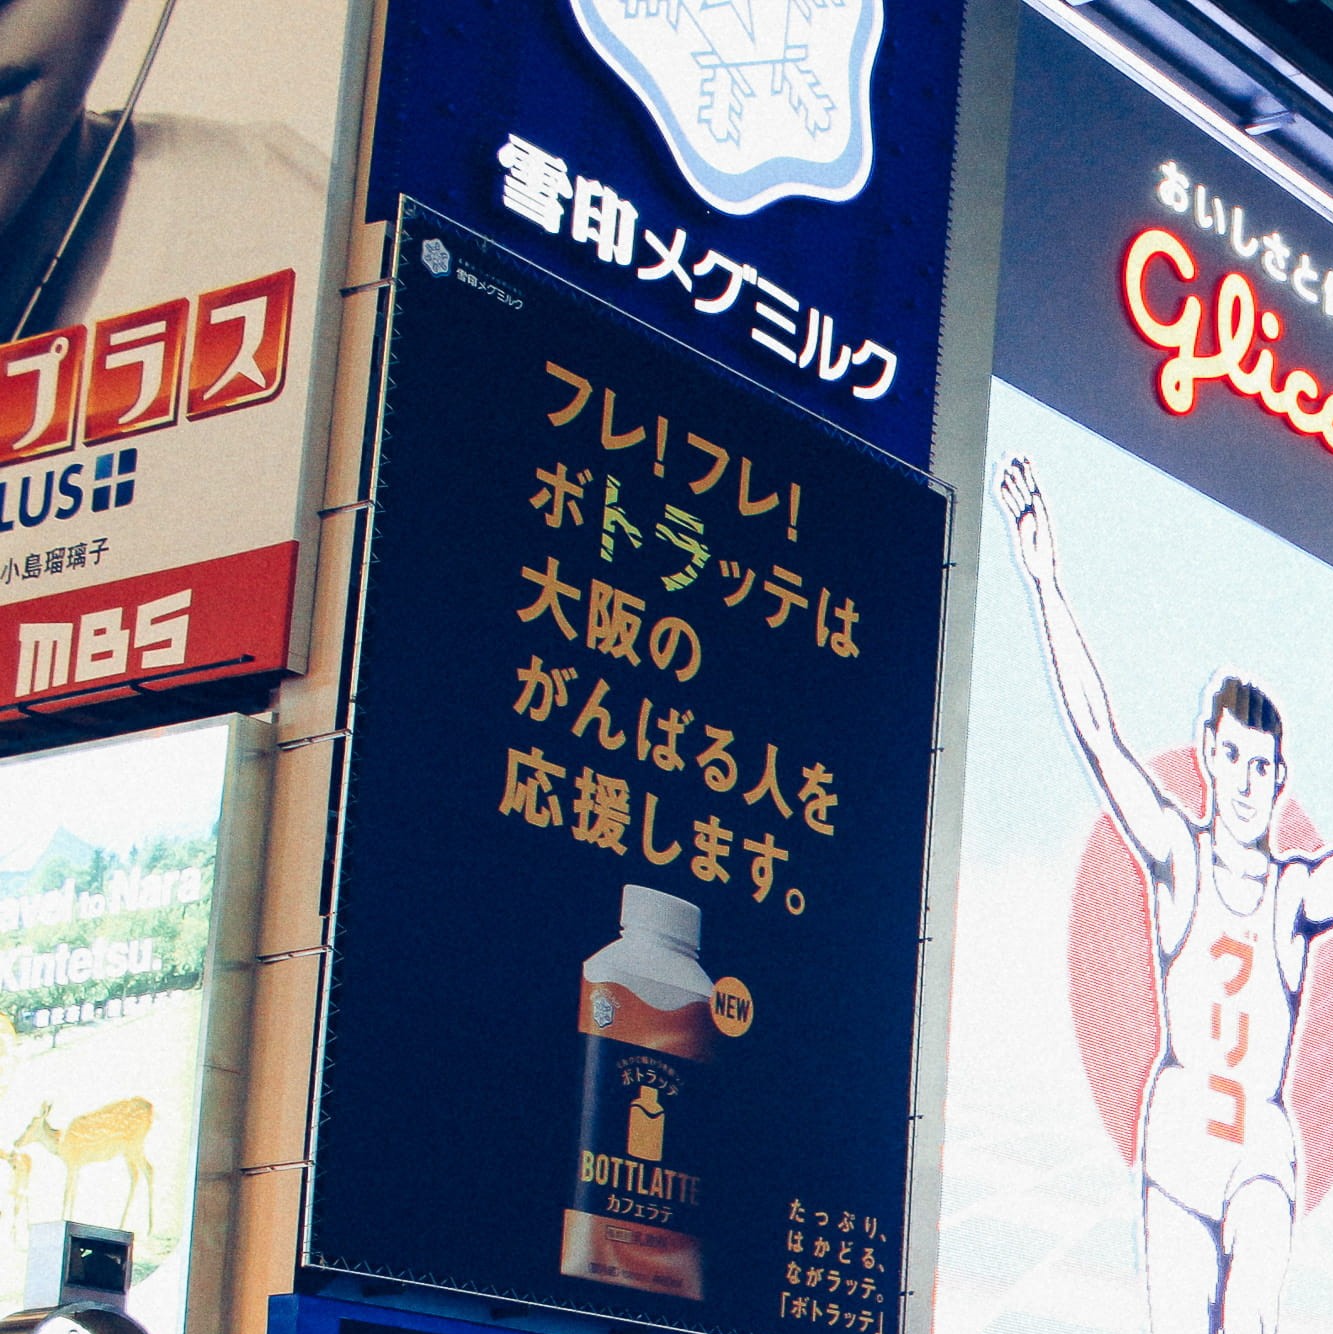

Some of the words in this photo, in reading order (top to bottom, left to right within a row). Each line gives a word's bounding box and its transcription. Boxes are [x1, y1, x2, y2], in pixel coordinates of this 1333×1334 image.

[498, 133, 898, 400] 雪印メグミルク
[6, 294, 269, 451] プラス
[0, 537, 110, 585] 小島瑠璃子
[528, 461, 860, 658] ボトラッテは
[15, 588, 193, 698] MBS
[516, 555, 702, 683] 大阪の
[512, 654, 839, 836] がんばる人を
[497, 745, 806, 916] 応援します。
[108, 865, 202, 915] Nara
[0, 937, 163, 992] Kintetsu.
[715, 991, 751, 1024] NEW
[1205, 930, 1259, 1145] グリコ
[620, 1068, 680, 1097] ボトラッテ
[580, 1150, 702, 1206] BOTTLATTE
[606, 1193, 674, 1225] カフェラテ
[789, 1198, 888, 1243] たっぷり、
[786, 1228, 886, 1274] はかどる、
[786, 1260, 886, 1304] ながラッテ。
